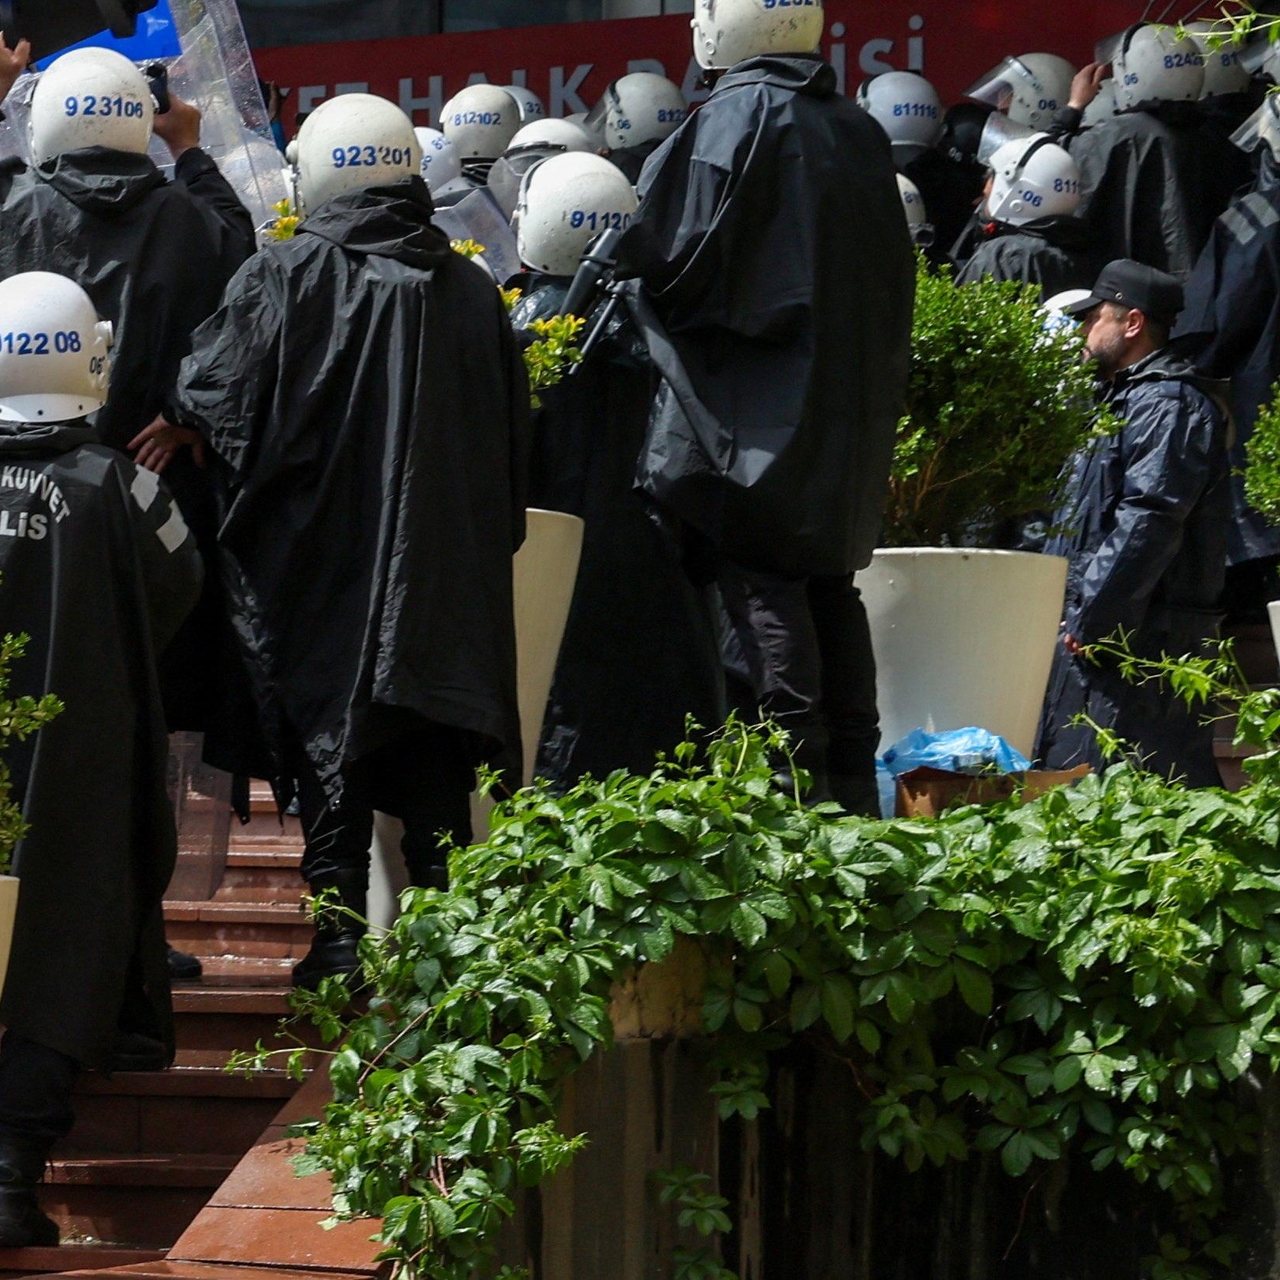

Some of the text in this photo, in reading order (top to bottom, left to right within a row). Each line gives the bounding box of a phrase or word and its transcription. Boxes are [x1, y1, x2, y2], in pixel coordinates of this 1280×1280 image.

[65, 94, 144, 120] 923106
[1037, 98, 1058, 111] 06
[1022, 189, 1043, 207] 06
[0, 464, 71, 524] KUVVET
